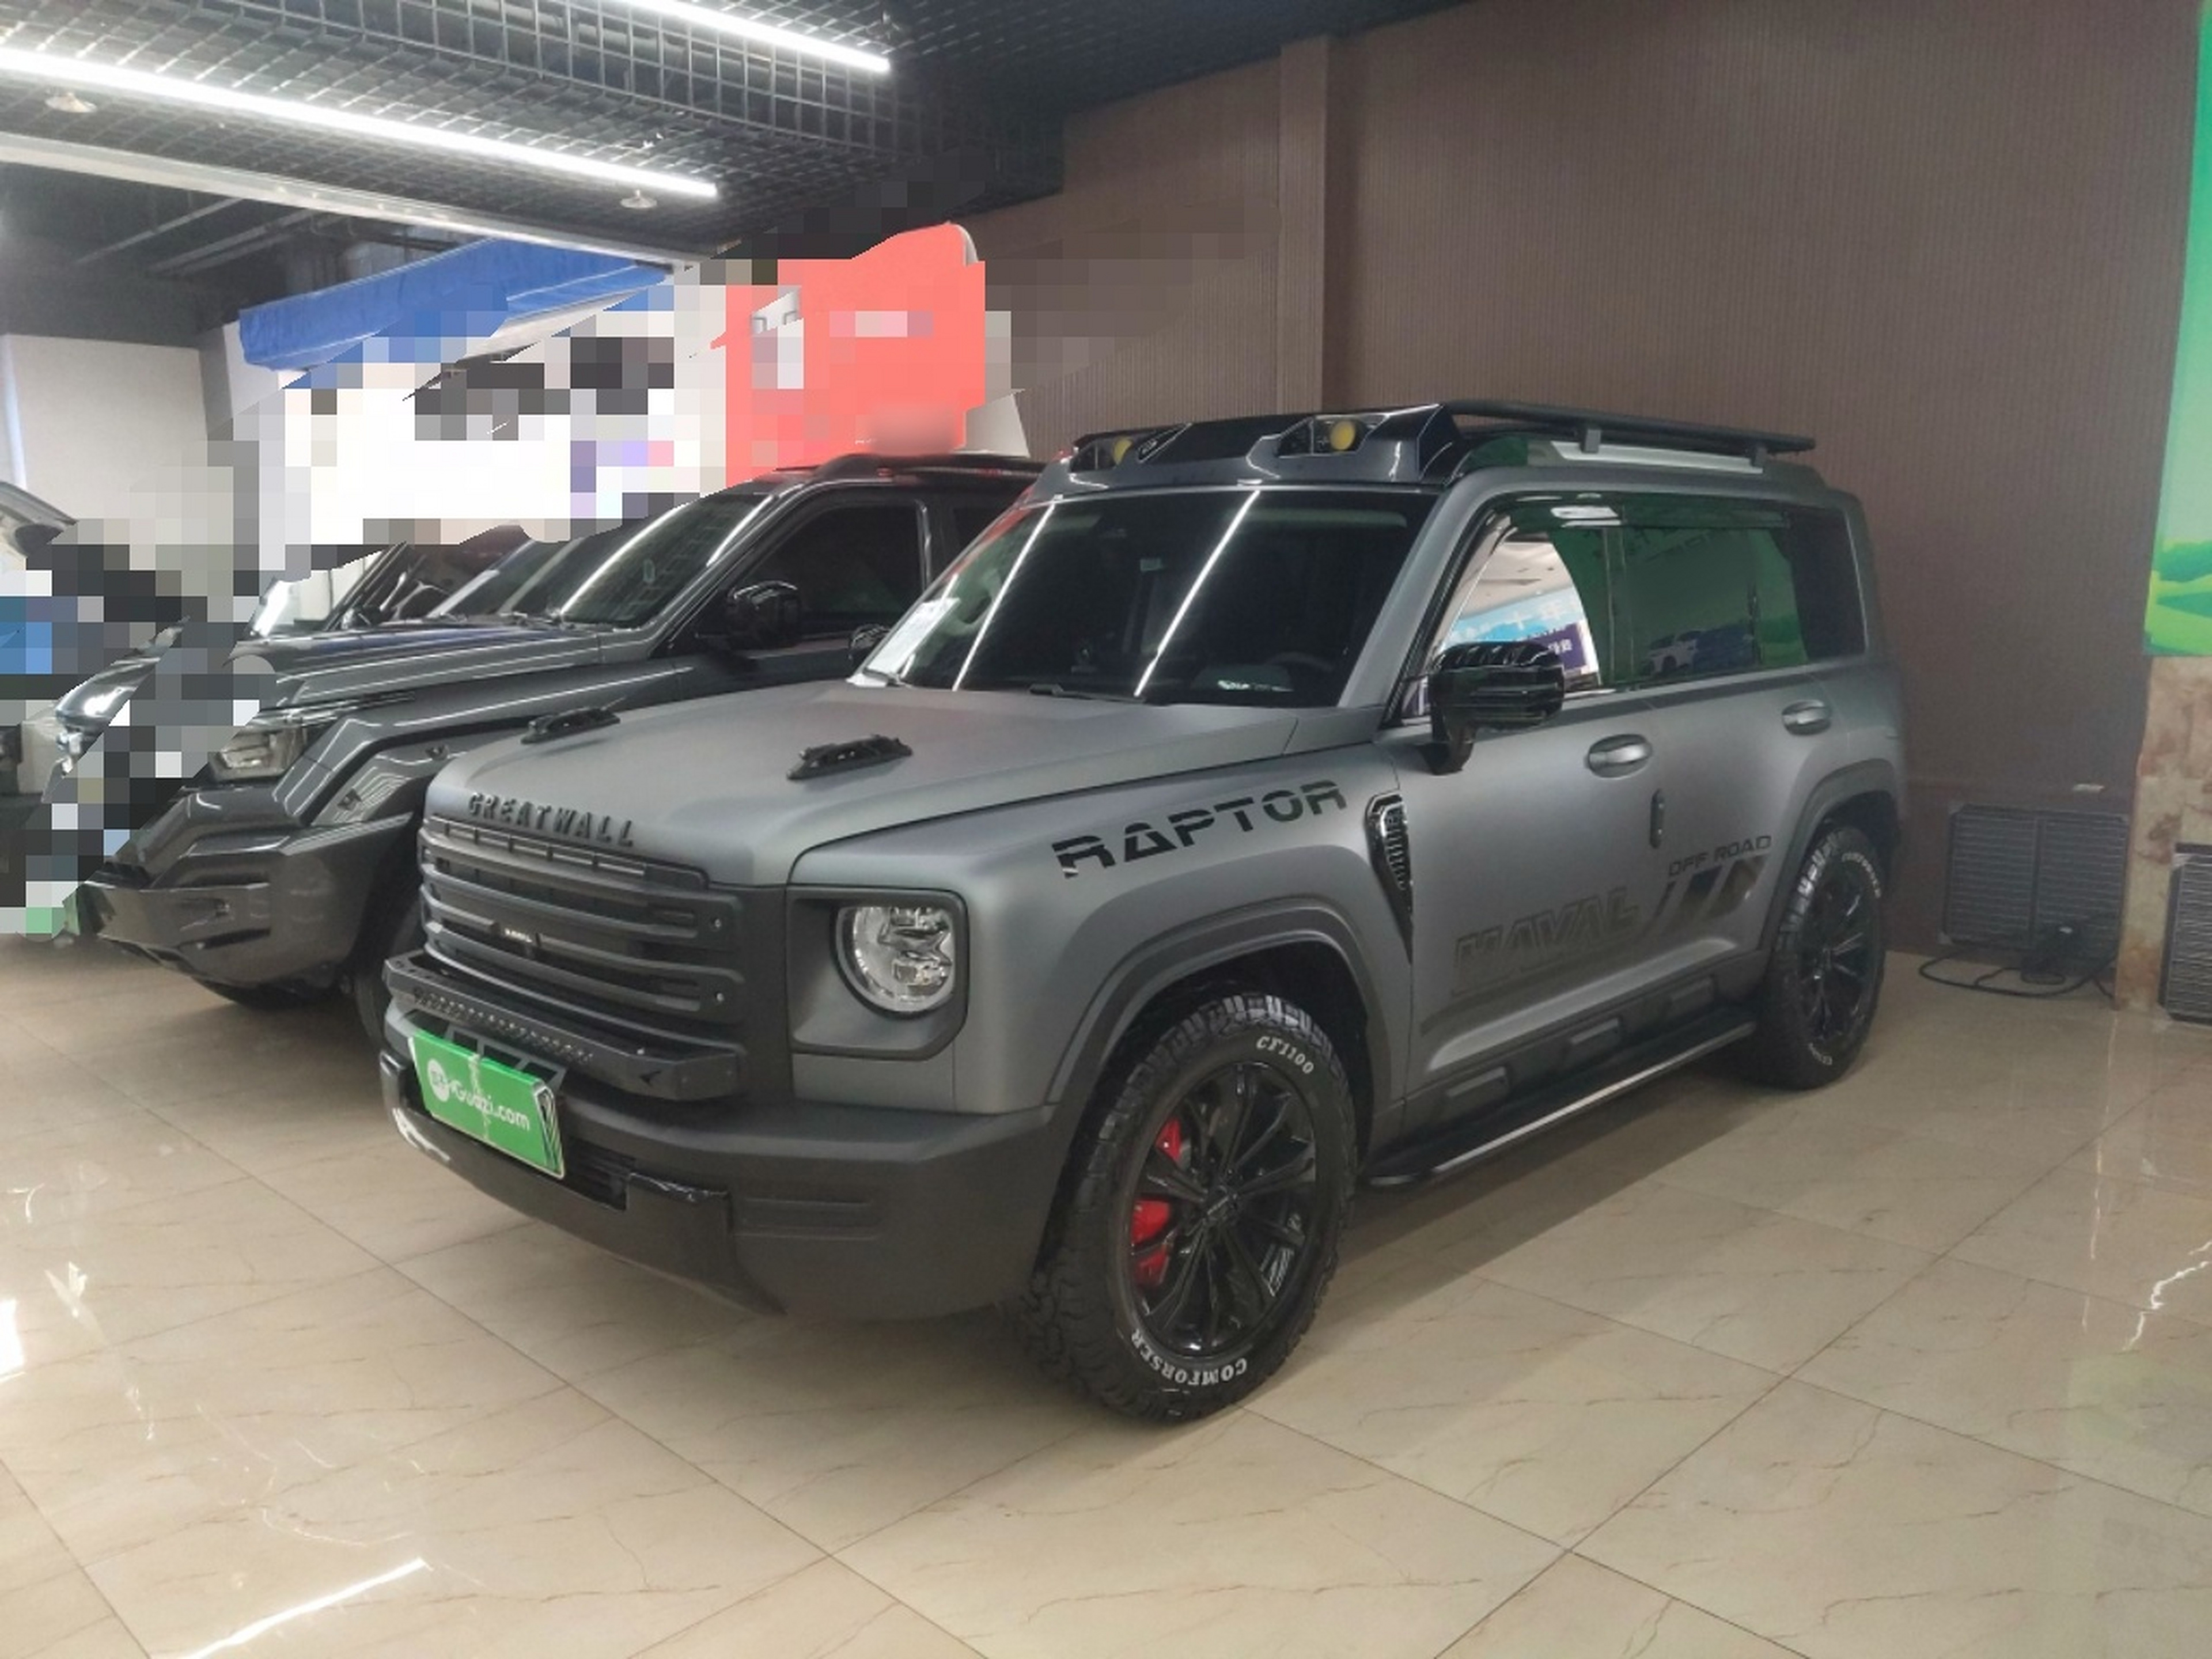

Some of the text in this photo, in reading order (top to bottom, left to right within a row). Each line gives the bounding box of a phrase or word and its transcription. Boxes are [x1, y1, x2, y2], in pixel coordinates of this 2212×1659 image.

[469, 793, 632, 847] GREATWALL
[1052, 780, 1347, 879] RAPTOR
[1669, 836, 1772, 876] OFF ROAD
[1256, 1036, 1314, 1074] CF1100
[1131, 1328, 1248, 1386] COMFORSER
